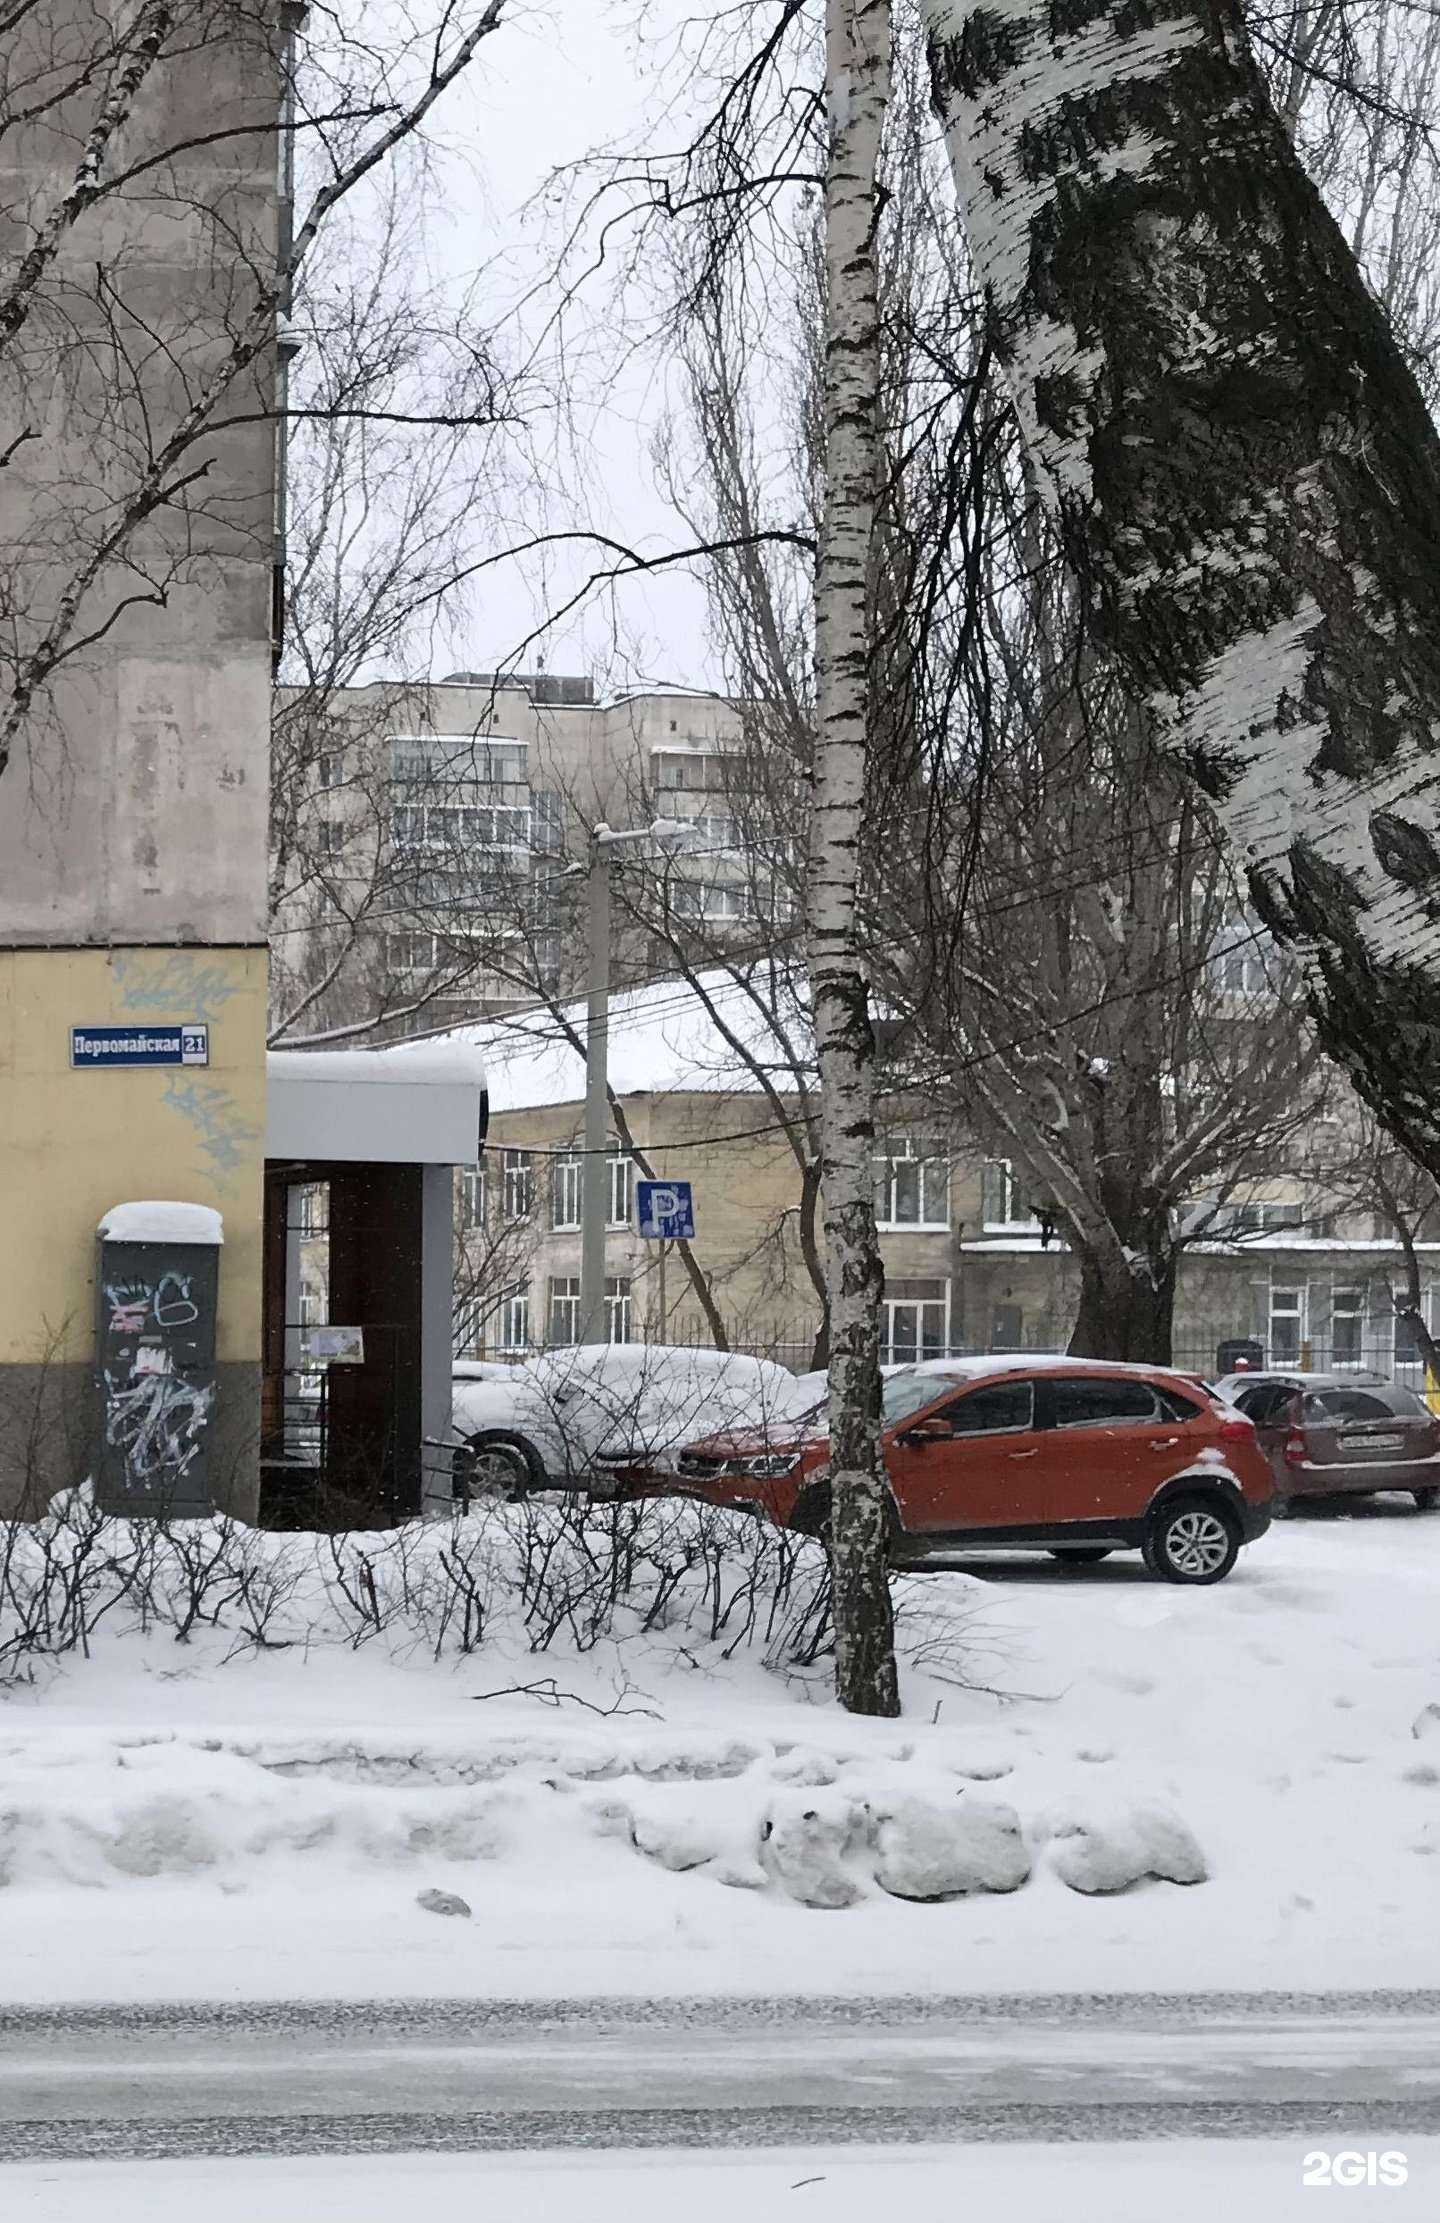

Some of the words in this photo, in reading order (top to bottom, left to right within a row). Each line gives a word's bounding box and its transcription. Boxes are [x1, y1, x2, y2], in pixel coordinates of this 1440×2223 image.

[74, 1034, 180, 1057] Первомайская
[185, 1037, 204, 1052] 21
[651, 1189, 680, 1233] P
